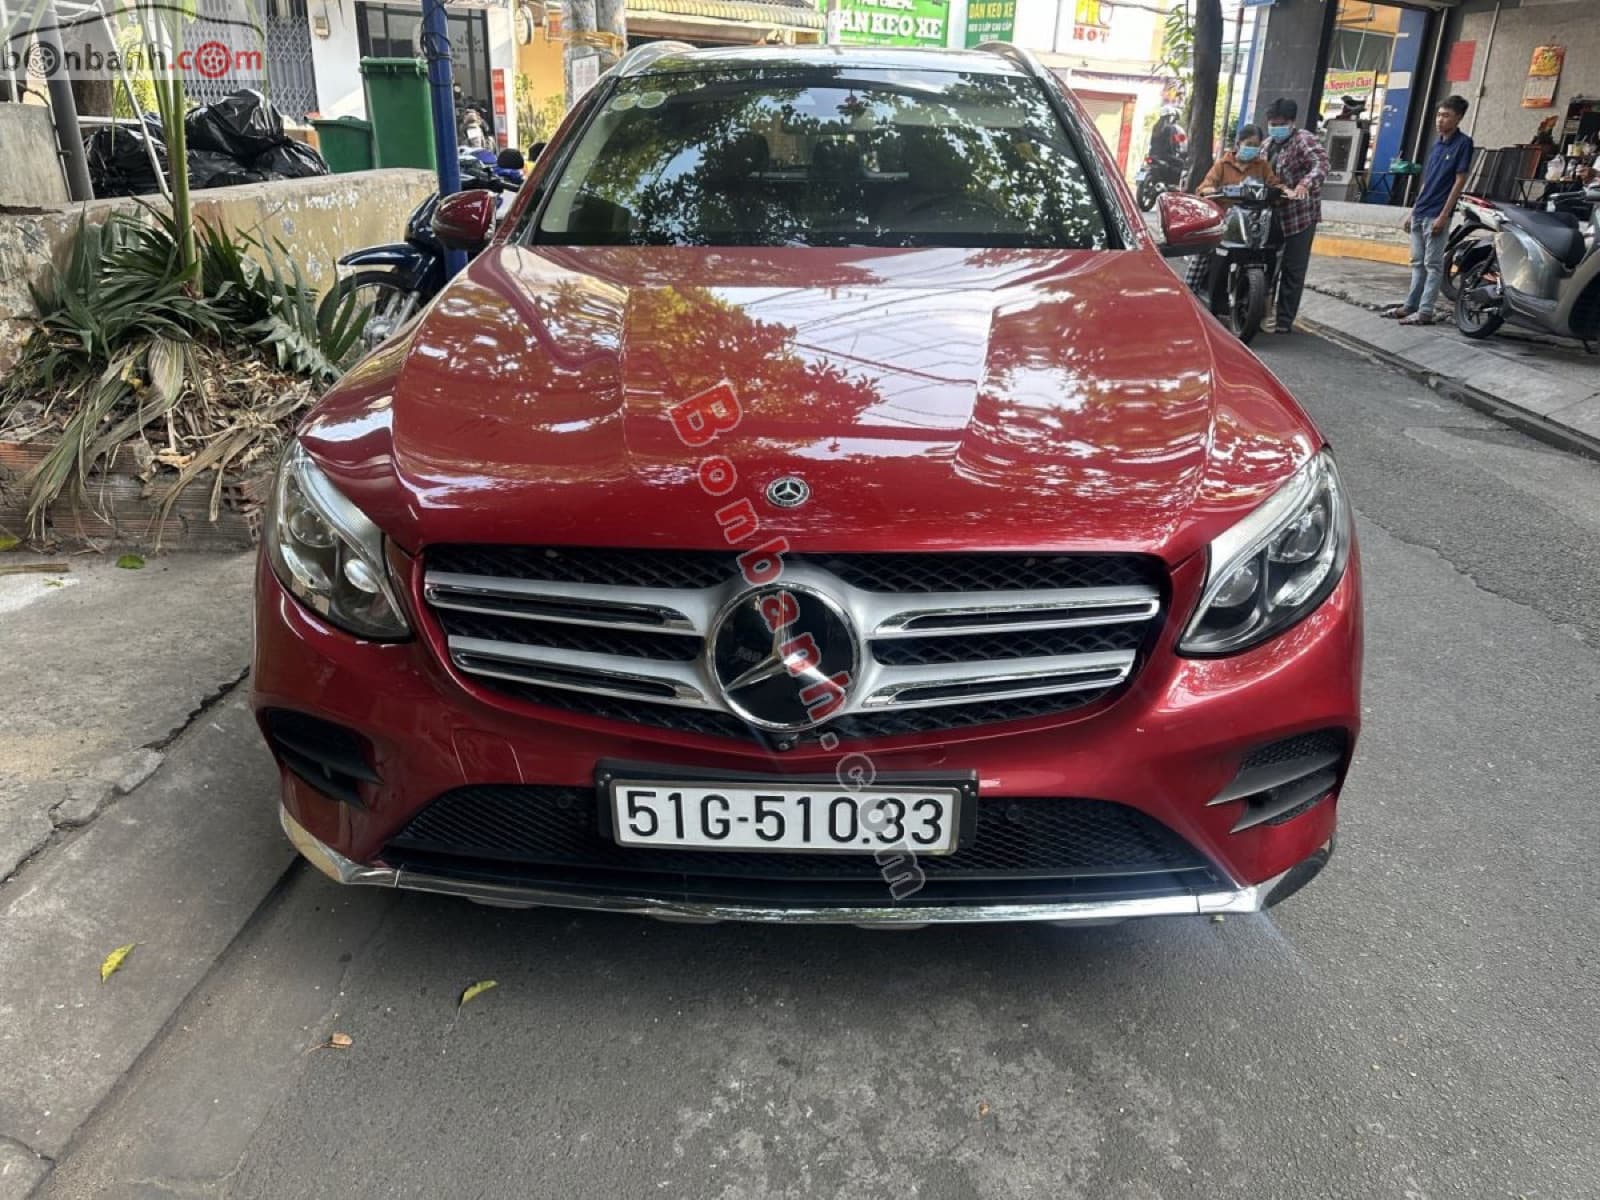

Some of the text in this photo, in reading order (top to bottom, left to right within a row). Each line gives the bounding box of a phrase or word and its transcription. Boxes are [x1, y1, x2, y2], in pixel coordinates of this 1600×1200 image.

[870, 11, 914, 37] KEO
[914, 16, 943, 39] XE
[1072, 27, 1110, 43] HOT
[626, 789, 944, 845] 51G-510.33
